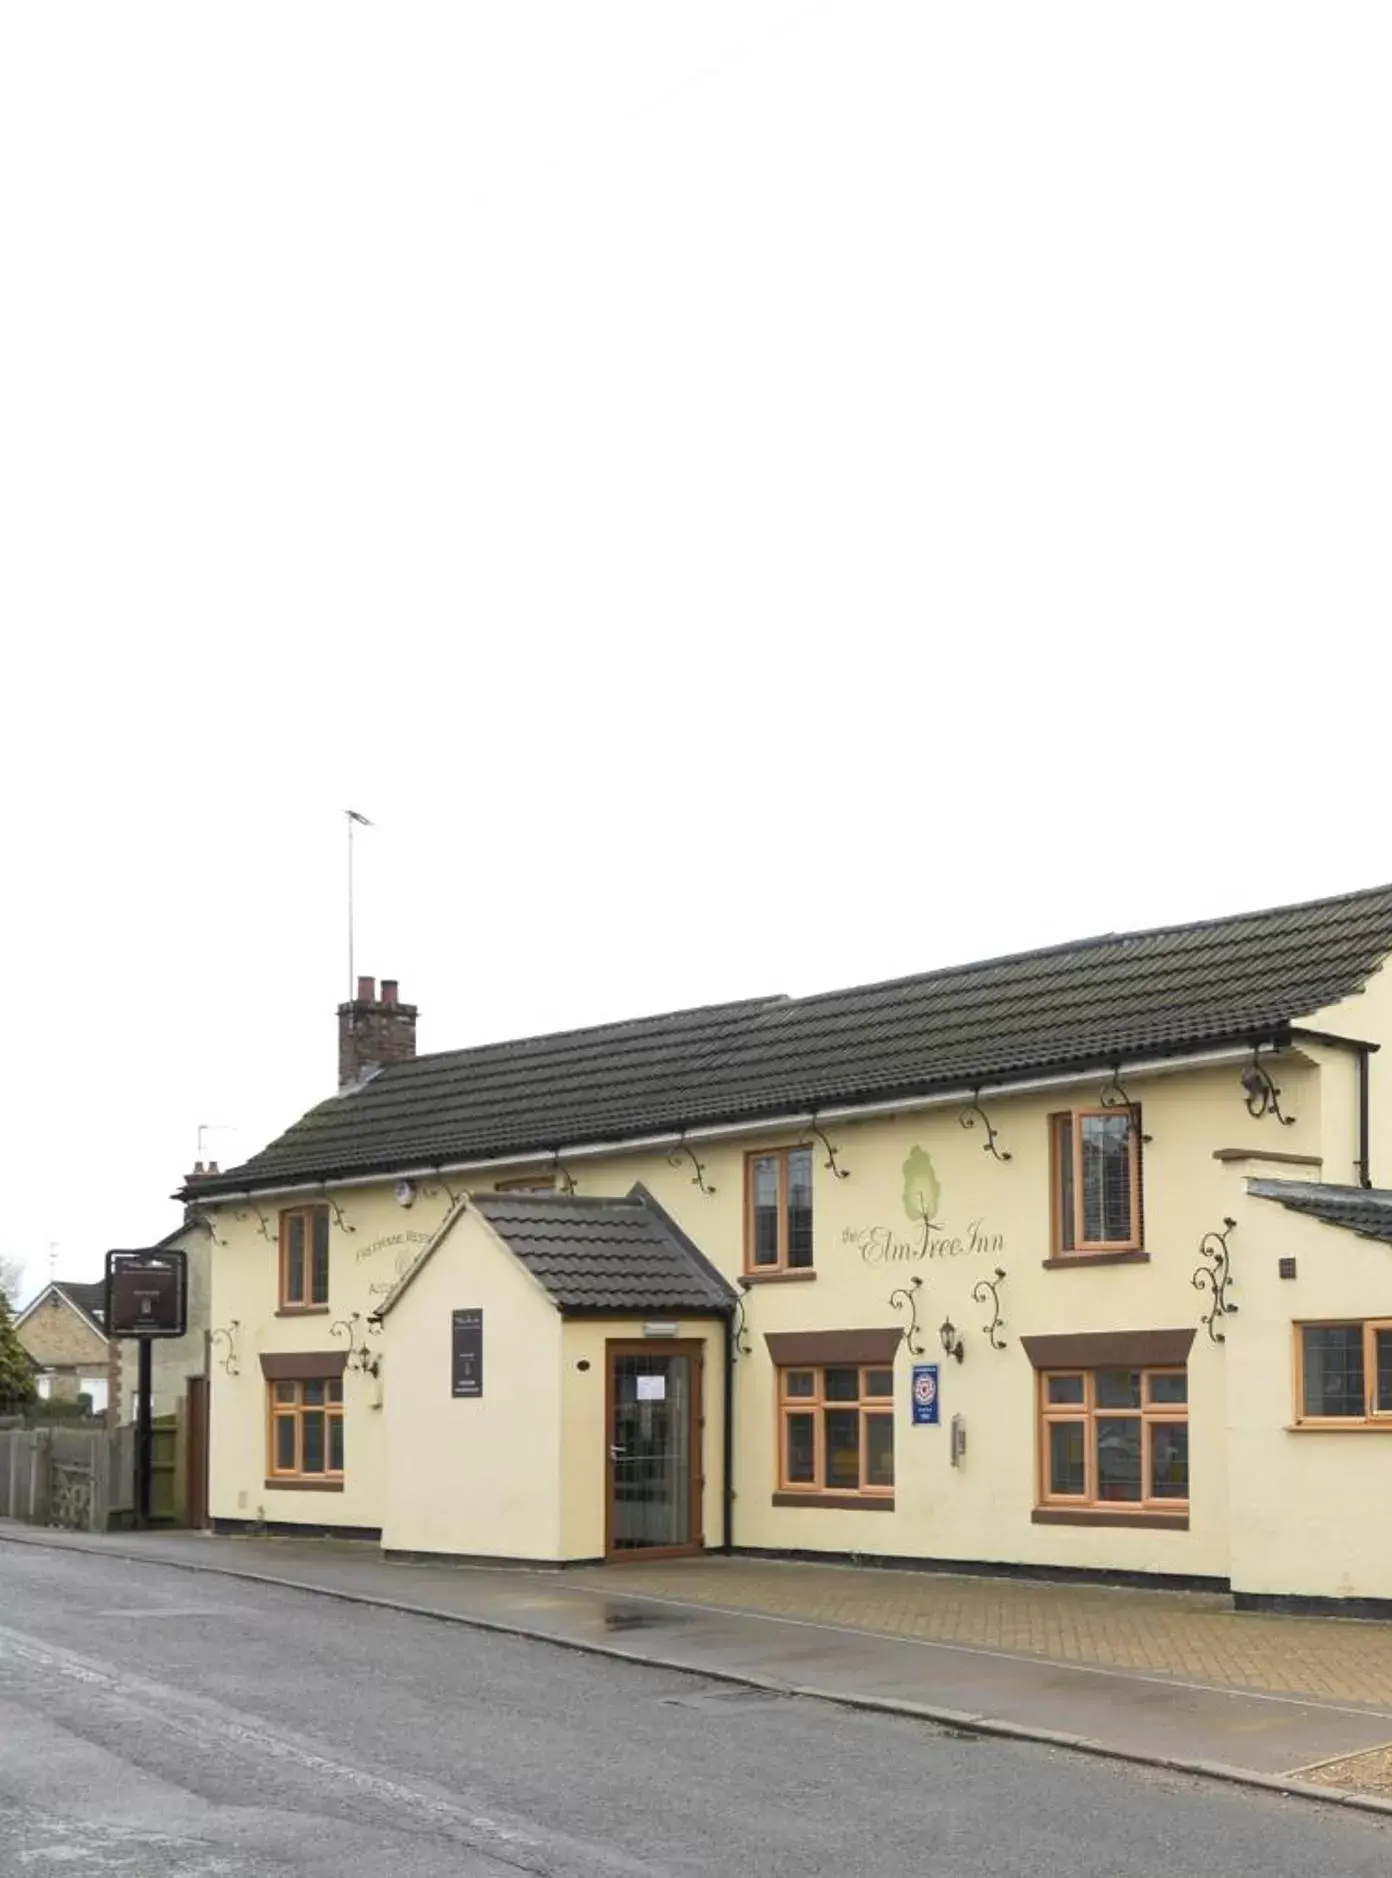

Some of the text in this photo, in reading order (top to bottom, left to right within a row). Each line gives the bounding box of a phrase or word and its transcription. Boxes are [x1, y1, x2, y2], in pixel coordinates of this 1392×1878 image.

[859, 1225, 914, 1267] Elm
[914, 1218, 964, 1260] Tree
[965, 1217, 1005, 1254] Inn
